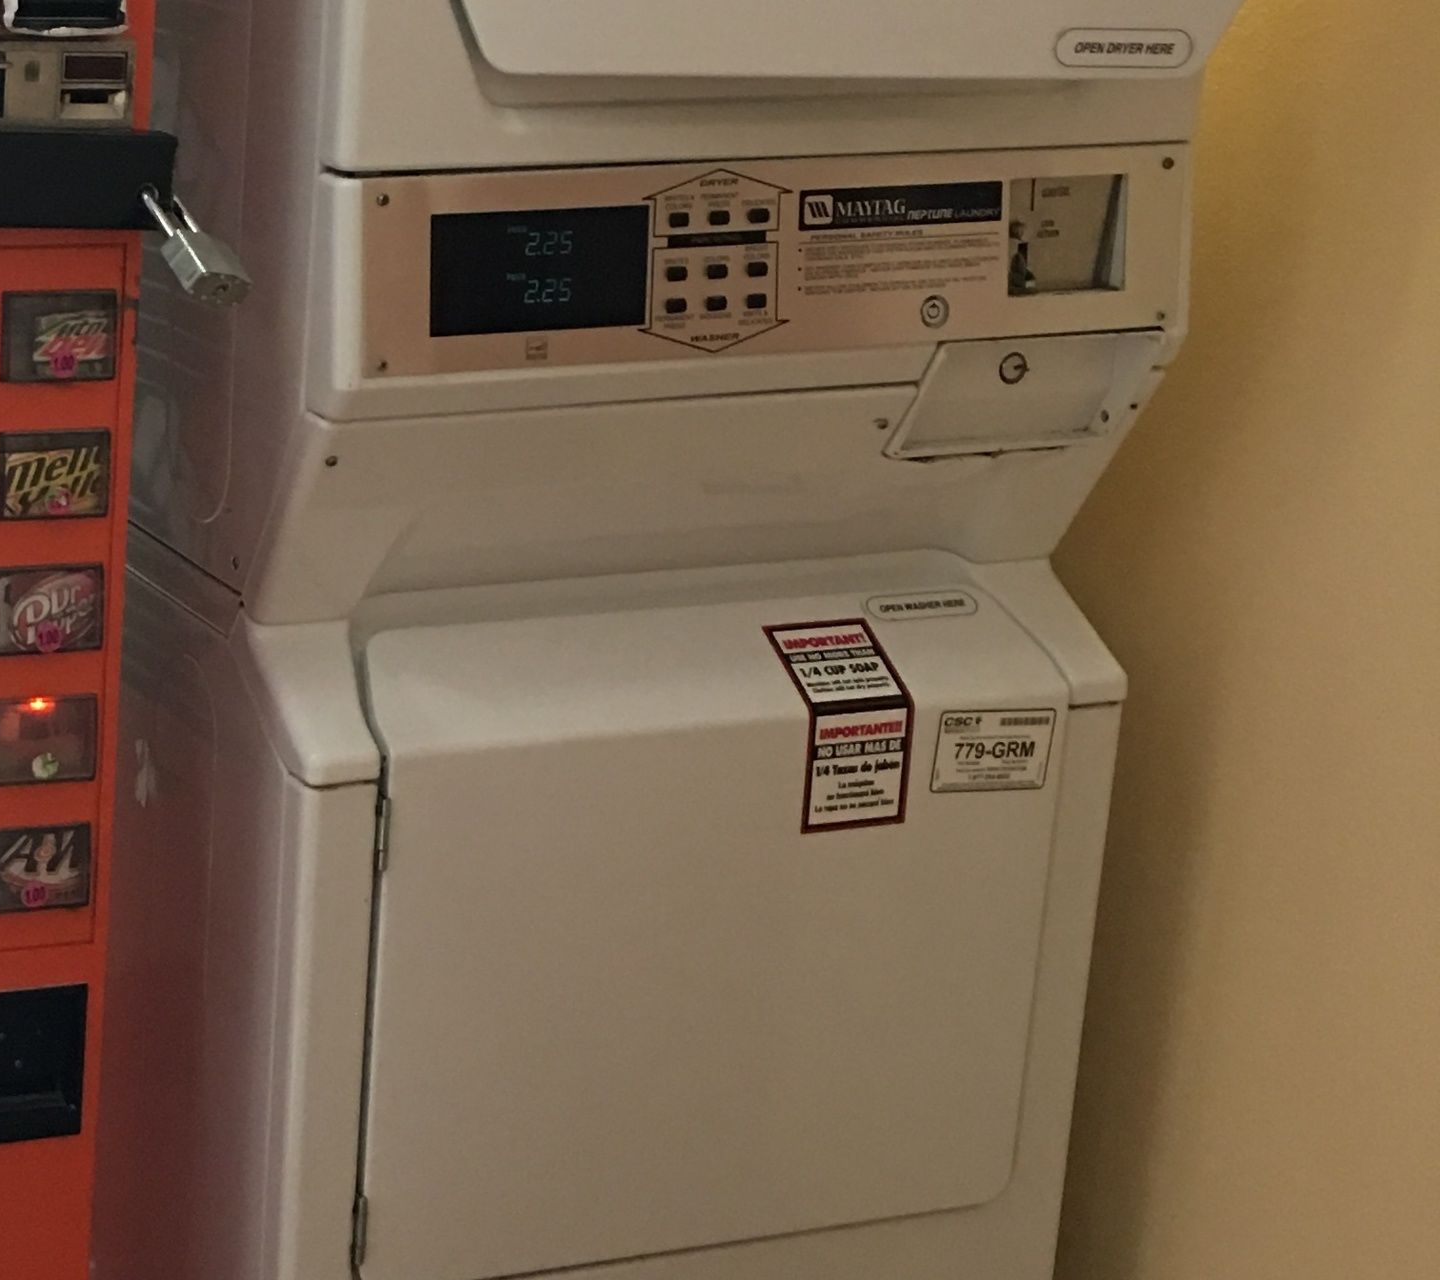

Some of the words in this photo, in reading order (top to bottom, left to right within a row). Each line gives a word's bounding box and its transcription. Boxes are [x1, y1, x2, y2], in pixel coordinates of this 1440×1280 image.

[1073, 41, 1106, 55] OPEN
[1106, 42, 1144, 55] DRYER
[1145, 42, 1176, 56] HERE
[699, 177, 740, 188] DRYER
[835, 199, 906, 218] MAYTAG
[525, 230, 574, 256] 2.25
[524, 278, 573, 304] 2.25
[690, 332, 740, 343] WASHER
[783, 632, 867, 650] IMPORTANT!
[800, 666, 823, 678] 1/4
[823, 664, 847, 676] CUP
[849, 661, 879, 674] SOAP
[944, 716, 974, 727] CSC
[817, 745, 834, 758] NO
[835, 743, 862, 757] USAR
[864, 740, 887, 754] MAS
[889, 739, 902, 751] DE
[954, 741, 1036, 760] 779-GRM
